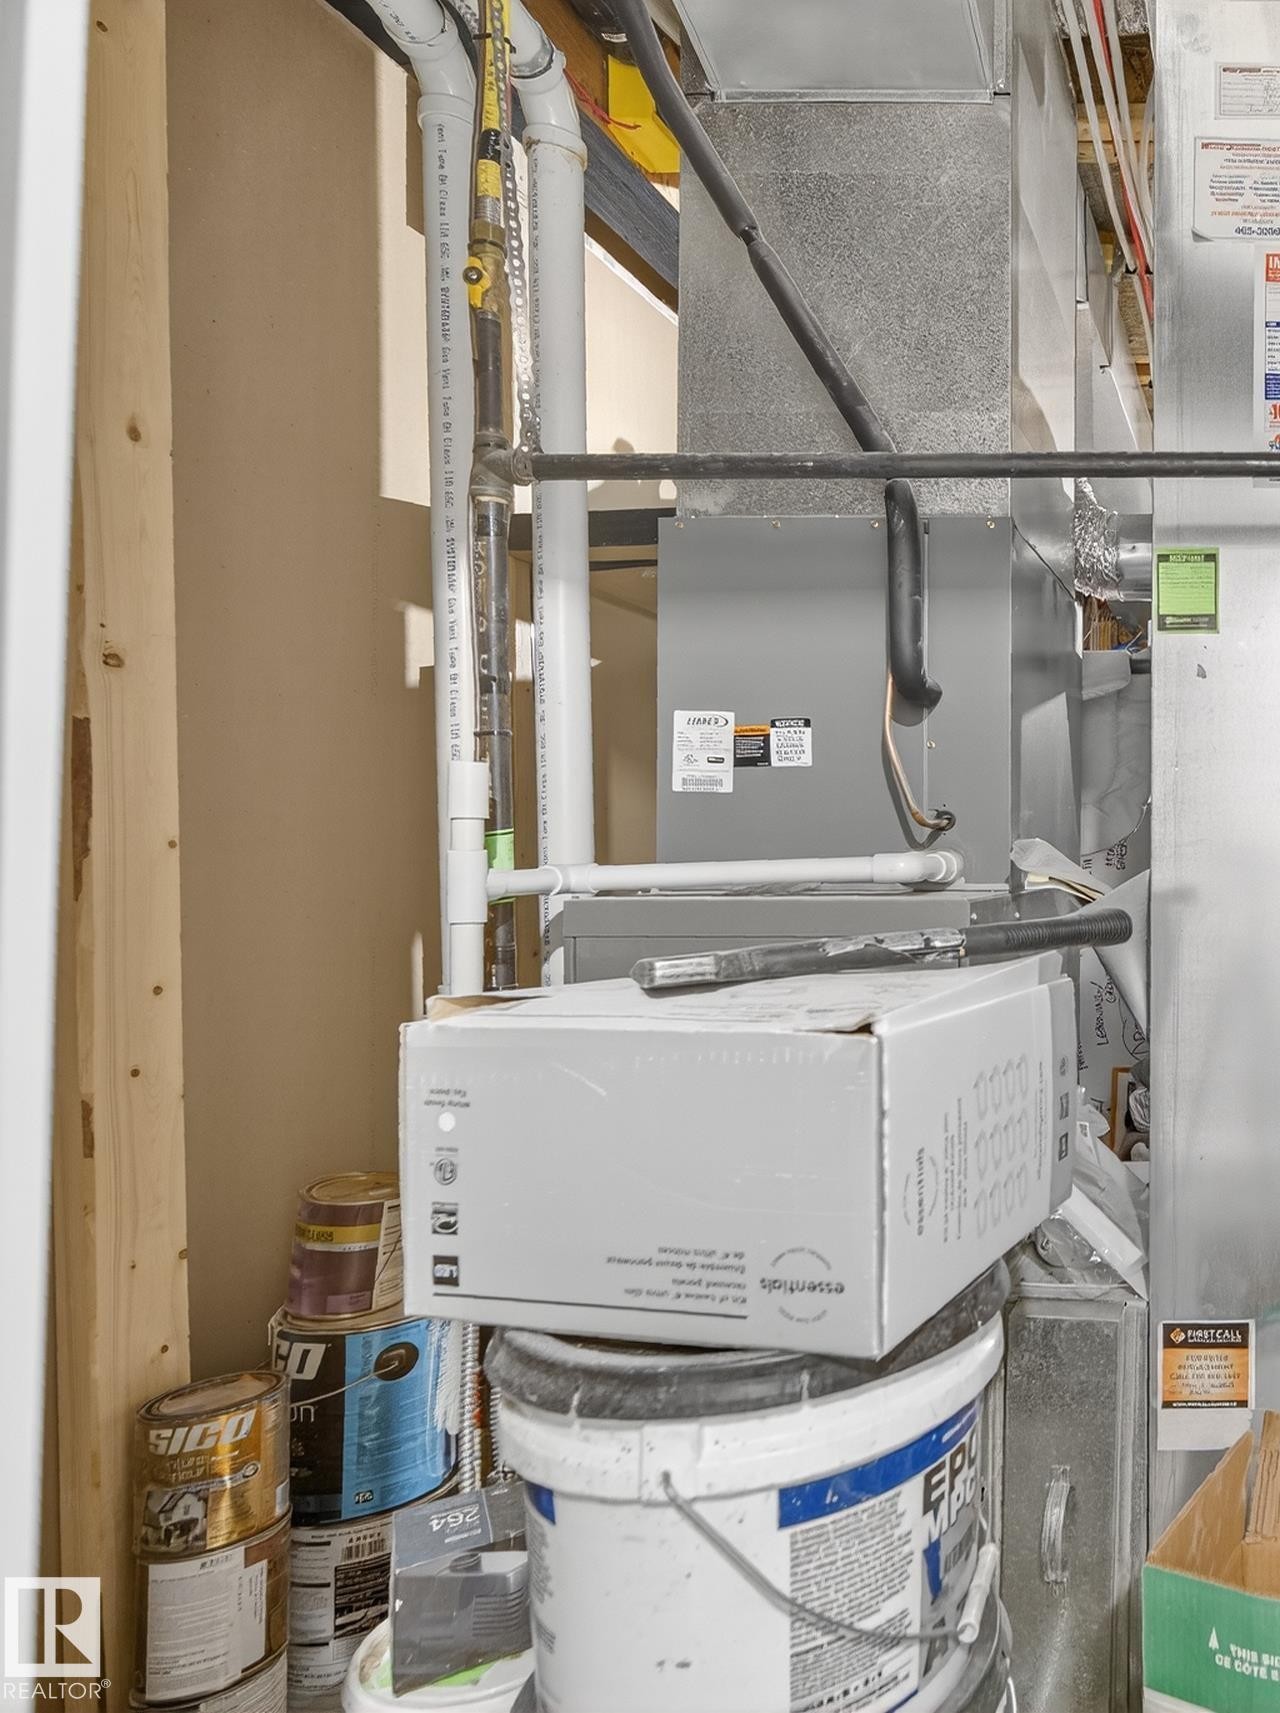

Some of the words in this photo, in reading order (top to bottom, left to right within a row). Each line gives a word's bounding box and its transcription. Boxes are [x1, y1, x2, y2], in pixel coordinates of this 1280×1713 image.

[759, 1277, 845, 1297] essentials
[149, 1408, 257, 1457] SICO
[1230, 1643, 1259, 1664] THIS
